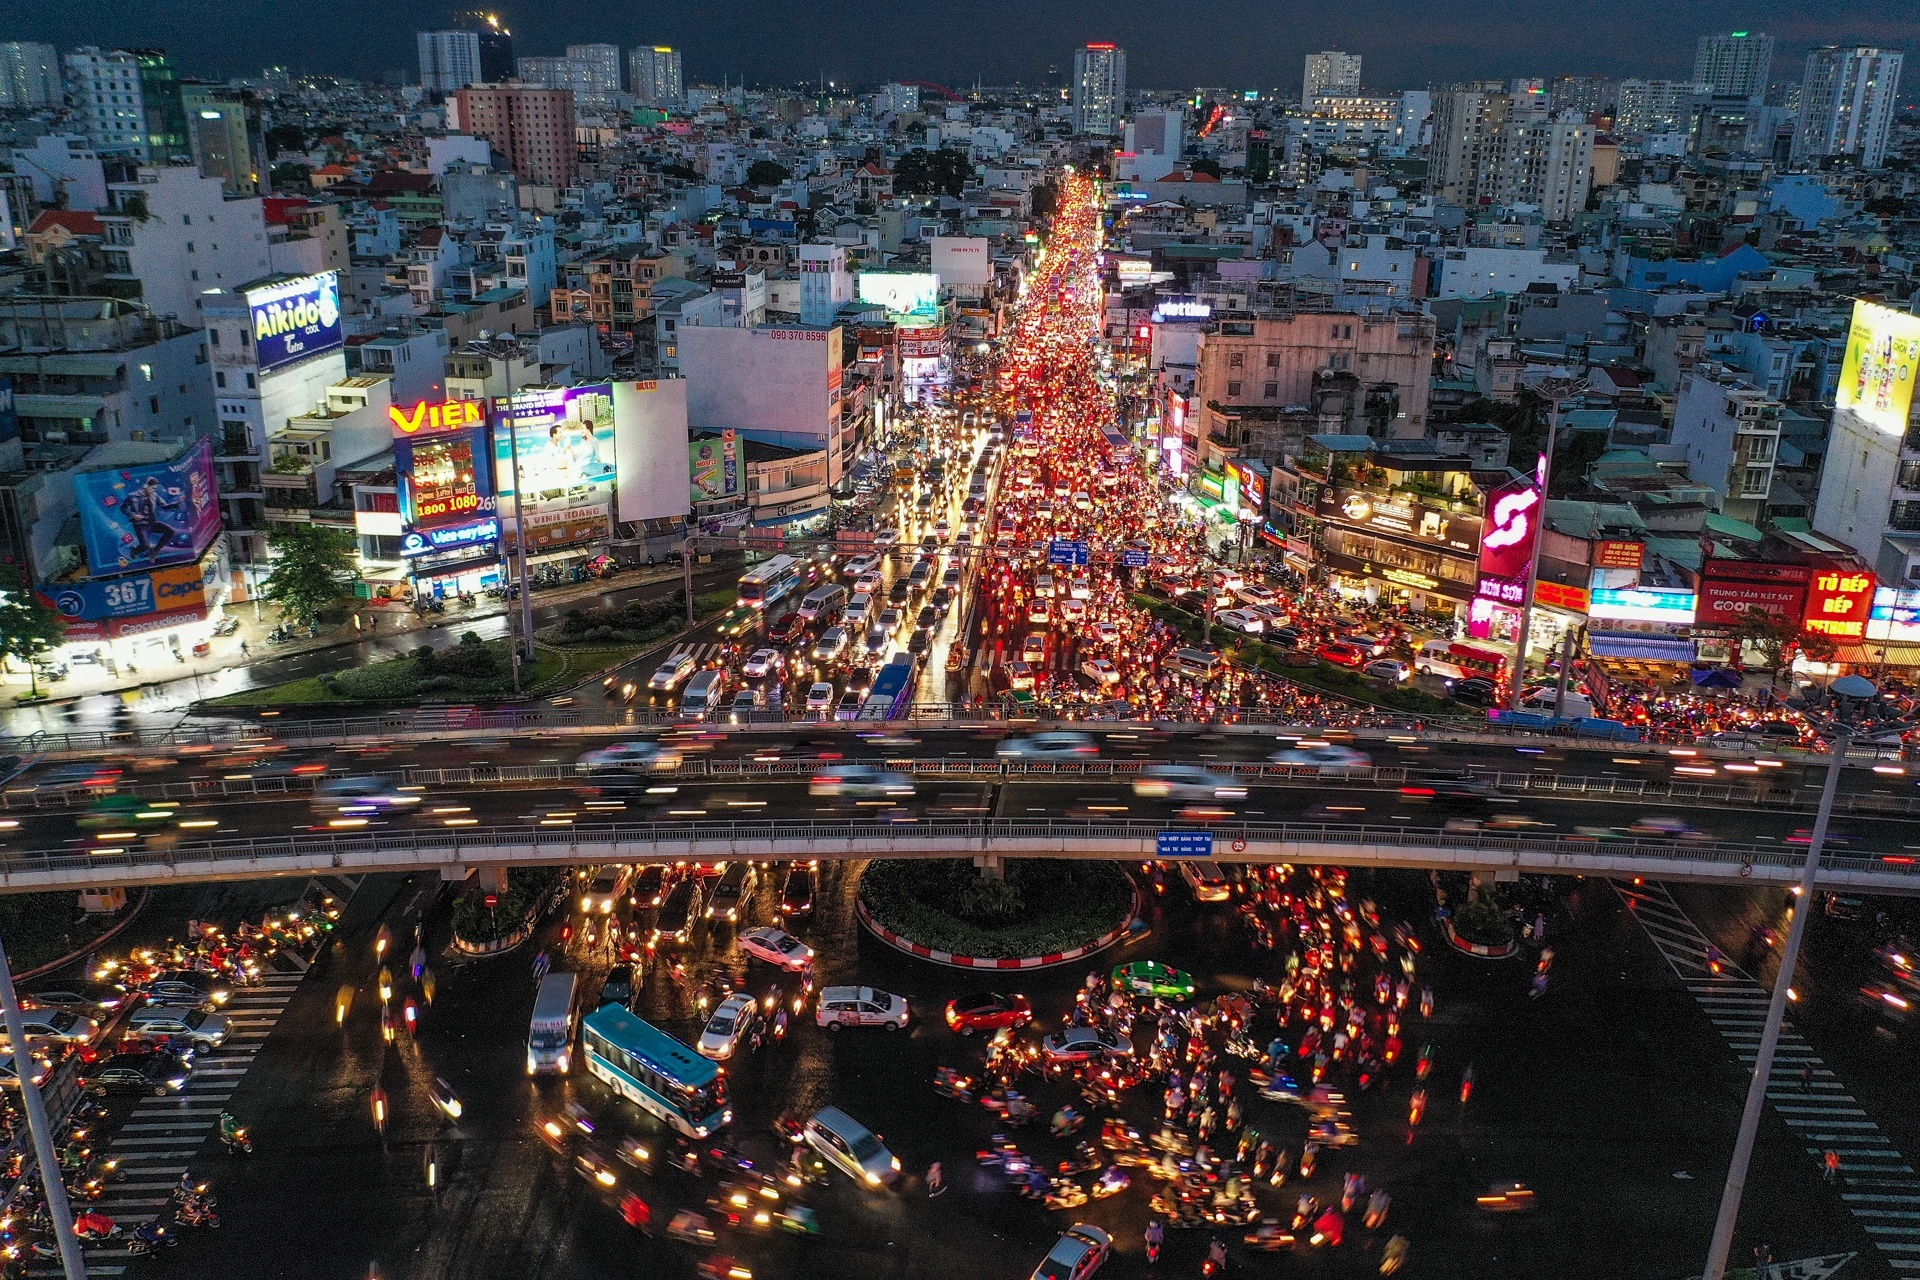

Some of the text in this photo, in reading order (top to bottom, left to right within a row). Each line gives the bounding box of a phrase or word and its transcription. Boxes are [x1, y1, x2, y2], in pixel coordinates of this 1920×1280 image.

[256, 296, 320, 341] Aikido
[305, 325, 320, 335] COOL
[772, 330, 826, 341] 090 370 8596
[389, 399, 484, 432] VIỆN
[512, 402, 534, 411] GRAND
[418, 494, 477, 517] 1800 1080
[788, 502, 812, 513] Electrolux
[104, 578, 150, 607] 367
[1817, 573, 1870, 593] TỦ BẾP
[1709, 588, 1738, 597] TRUNG
[1740, 589, 1758, 598] TÂM
[1823, 595, 1853, 613] BẾP
[120, 612, 198, 634] Capcuudidong
